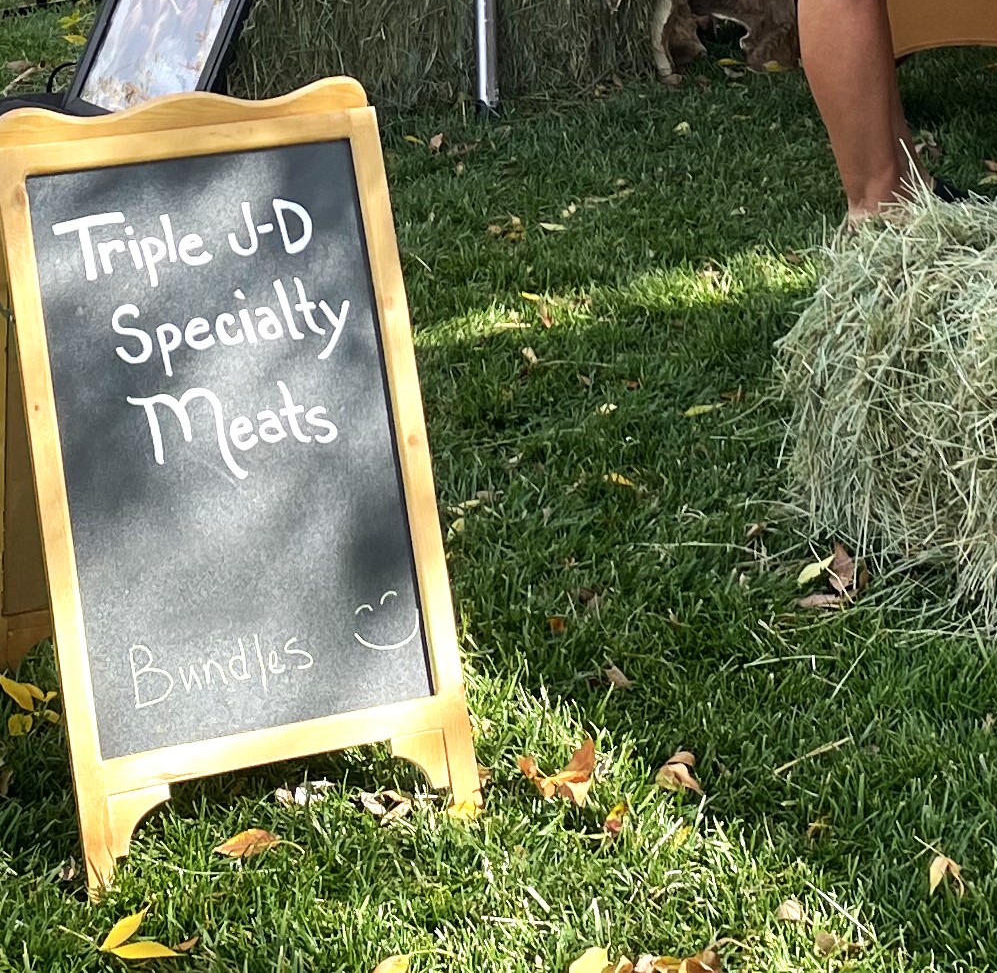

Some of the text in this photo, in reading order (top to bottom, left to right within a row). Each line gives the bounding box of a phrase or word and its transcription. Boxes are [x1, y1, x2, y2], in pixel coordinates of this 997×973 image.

[52, 198, 313, 287] Triple J-D
[111, 276, 350, 377] Specialty
[126, 380, 338, 480] Meats
[128, 634, 314, 709] Bundles
